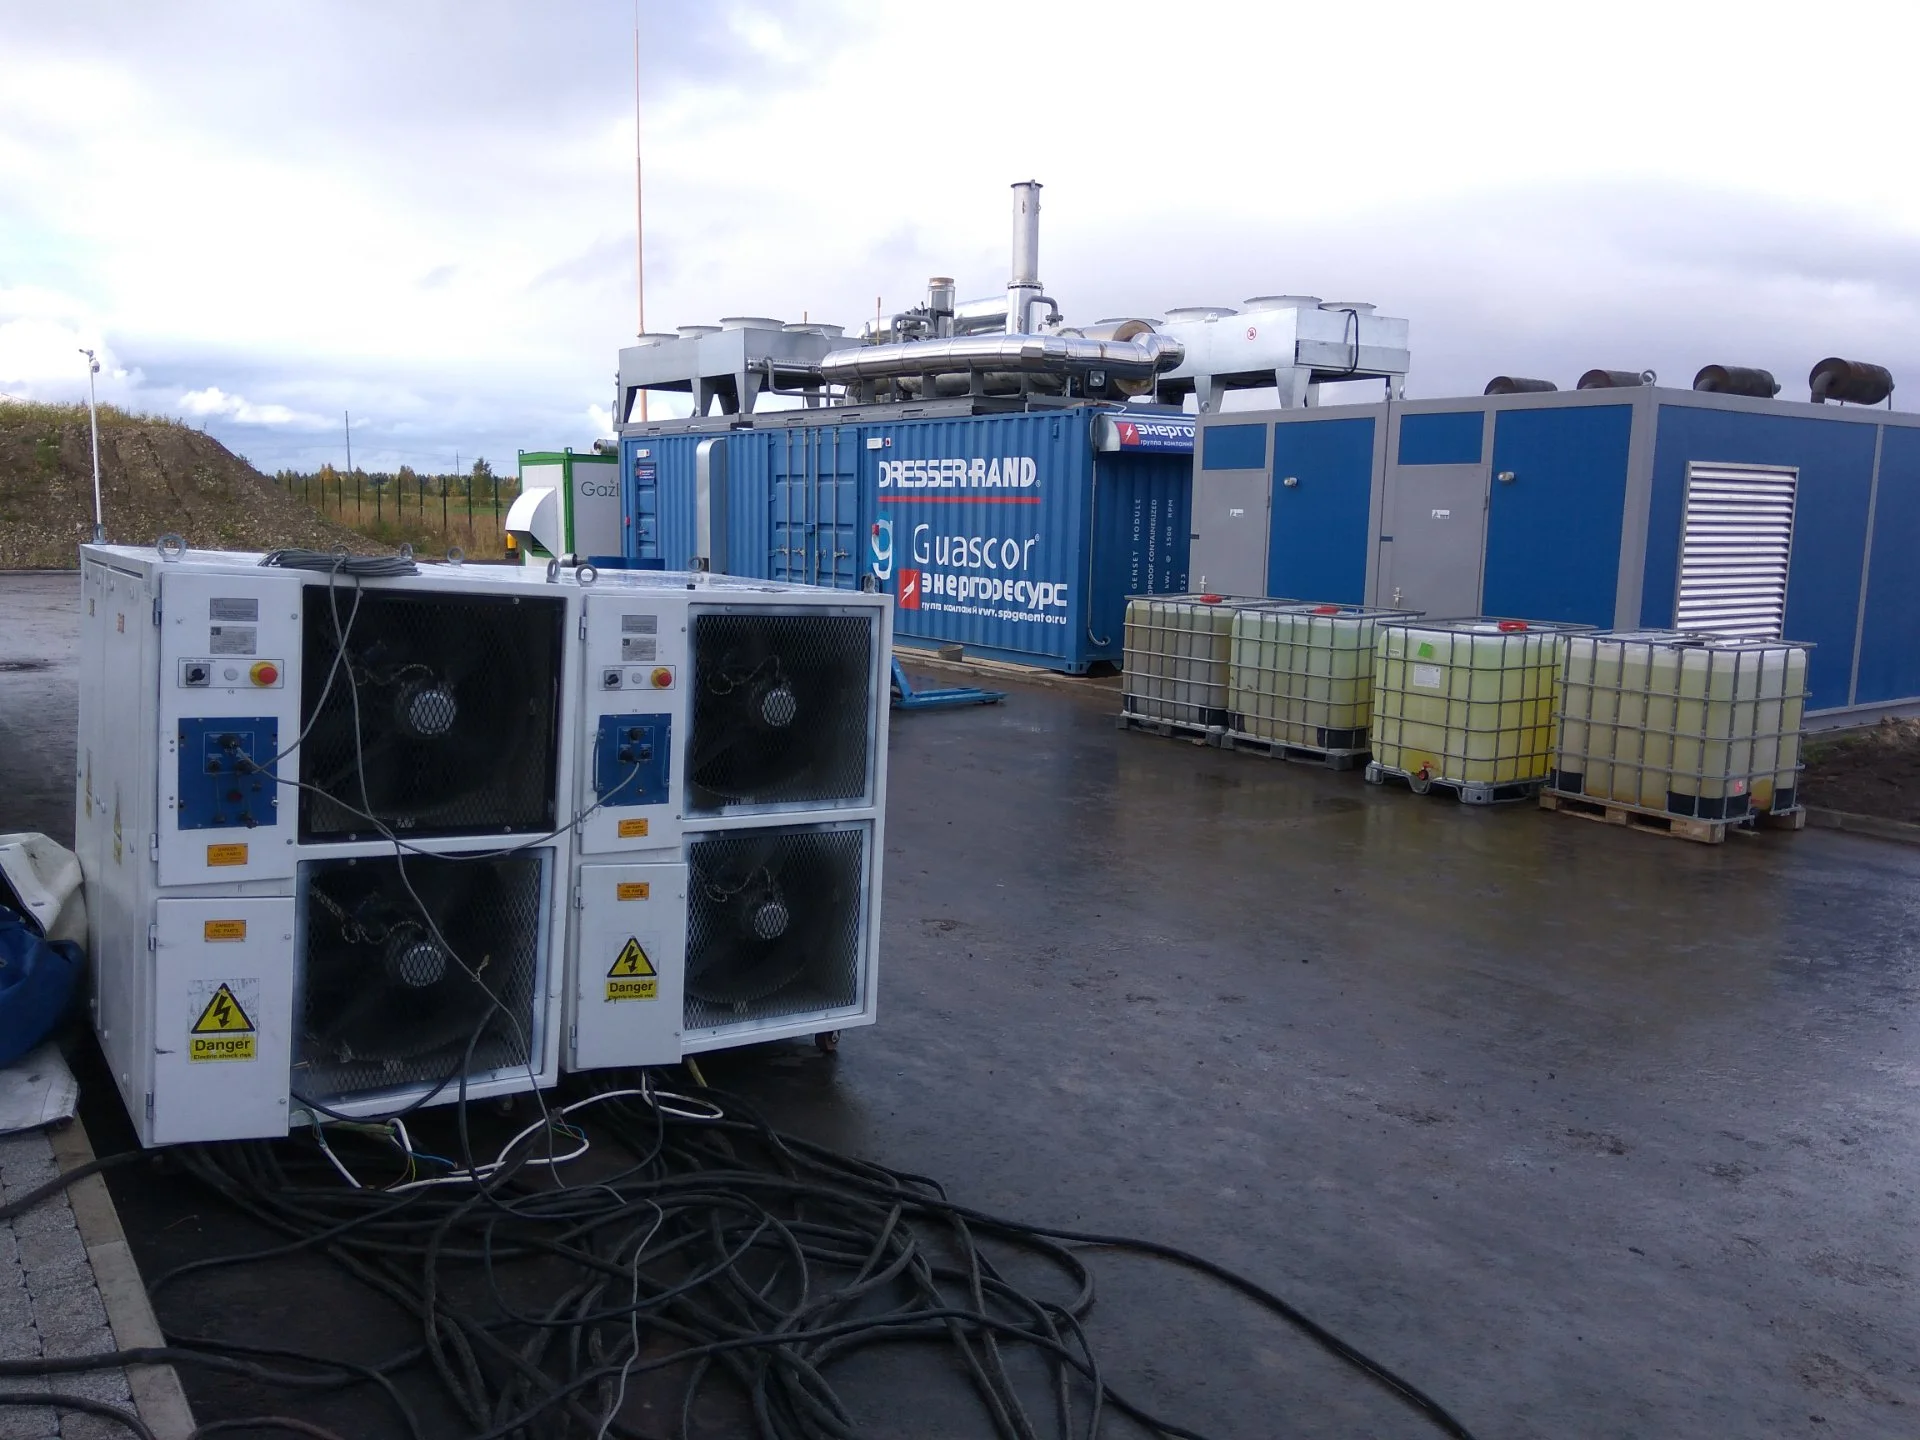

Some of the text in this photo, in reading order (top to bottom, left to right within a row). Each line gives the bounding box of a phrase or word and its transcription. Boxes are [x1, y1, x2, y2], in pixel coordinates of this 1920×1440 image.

[1140, 439, 1162, 447] группа
[1148, 499, 1157, 562] CONTAINERIZED
[1131, 499, 1141, 590] GENSET MODULE
[609, 982, 654, 993] Danger
[194, 1039, 250, 1053] Danger
